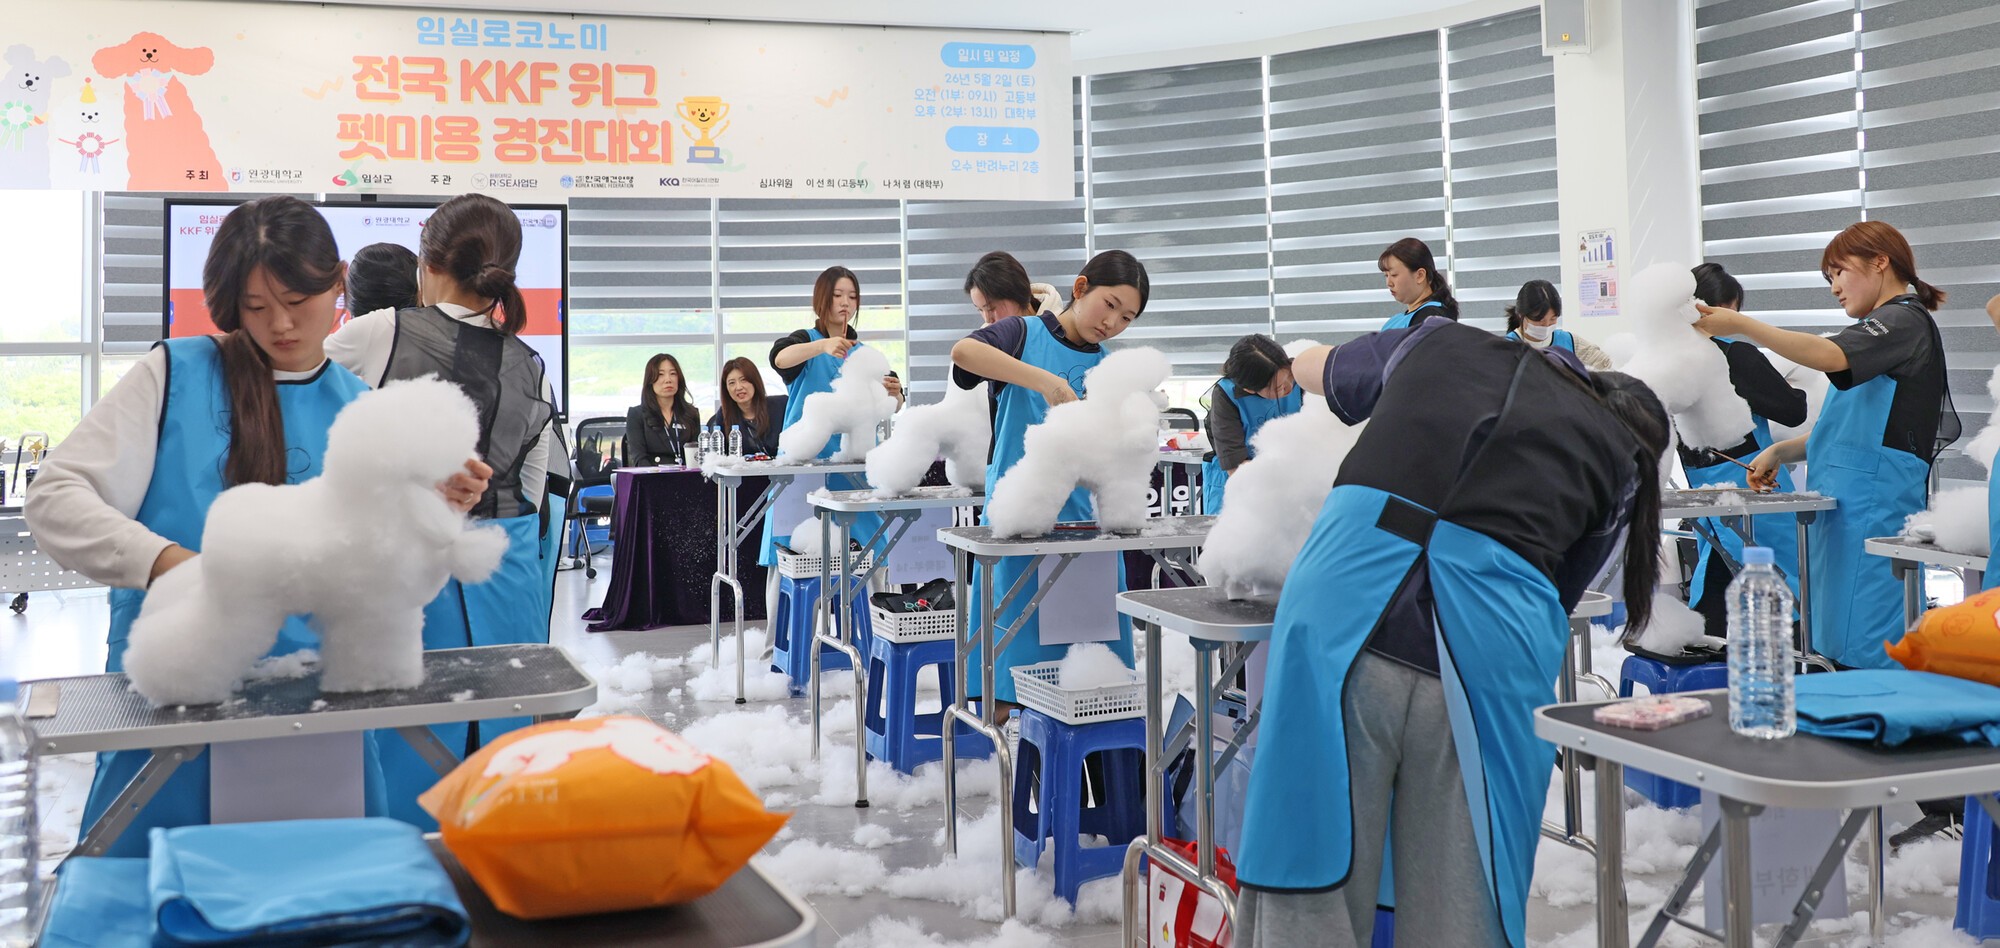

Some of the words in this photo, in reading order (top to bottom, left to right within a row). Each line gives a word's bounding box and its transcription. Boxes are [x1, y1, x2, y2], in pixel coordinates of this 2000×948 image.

[417, 16, 607, 51] 임실로코노미
[958, 48, 980, 62] 일시
[983, 49, 994, 62] 및
[998, 50, 1020, 63] 일정
[352, 55, 449, 103] 전국
[460, 59, 560, 104] KKF
[568, 62, 660, 107] 위그
[945, 73, 970, 86] 26년
[974, 74, 991, 87] 5월
[995, 75, 1012, 87] 2일
[1016, 75, 1036, 87] (토)
[914, 88, 936, 102] 오전
[940, 89, 964, 102] (1부:
[968, 90, 997, 102] 09시)
[1005, 91, 1036, 104] 고등부
[914, 105, 936, 118] 오후
[940, 106, 967, 118] (2부:
[971, 106, 997, 119] 13시)
[1004, 107, 1036, 120] 대학부
[336, 113, 481, 161] 펫미용
[492, 118, 674, 164] 경진대회
[248, 169, 303, 179] 원광대학교
[951, 159, 973, 172] 오수
[976, 160, 1019, 173] 반려누리
[1022, 161, 1039, 174] 2층
[361, 173, 393, 184] 임실군
[759, 178, 793, 189] 심사위원
[837, 179, 869, 189] (고등부)
[913, 179, 944, 189] (대학부)
[180, 226, 202, 235] KKF
